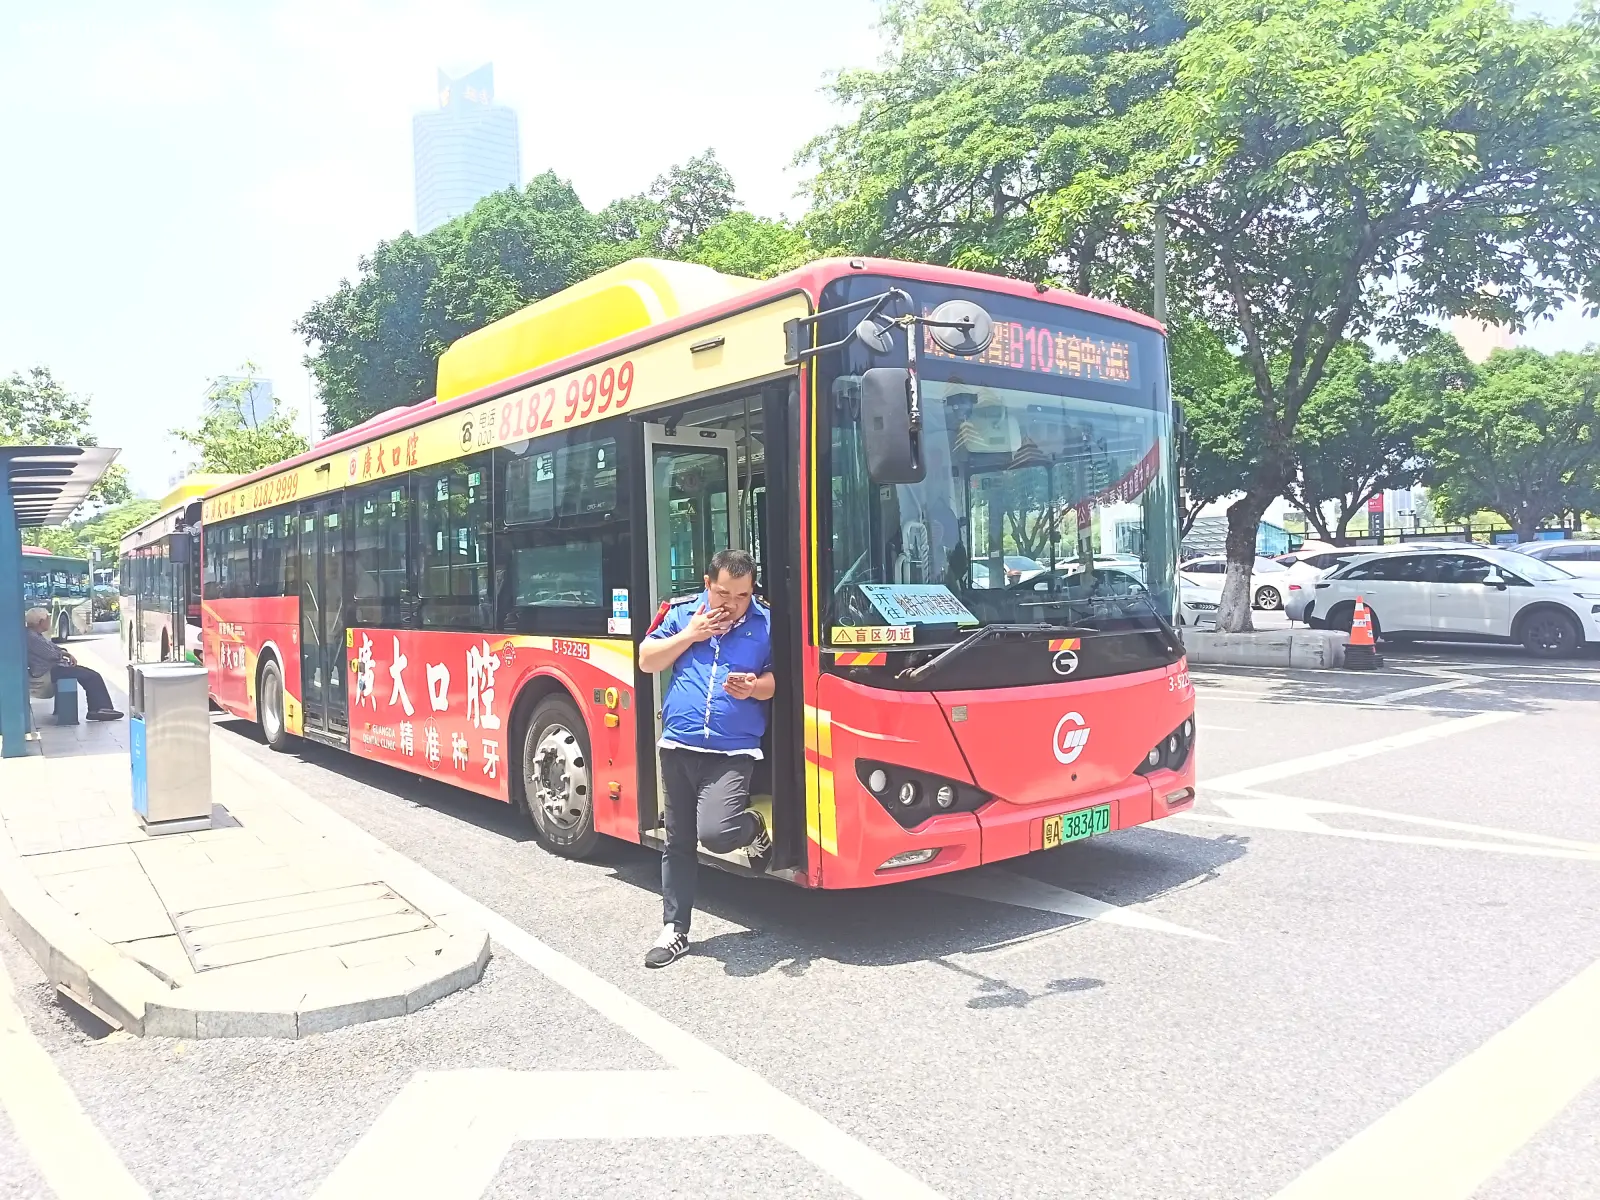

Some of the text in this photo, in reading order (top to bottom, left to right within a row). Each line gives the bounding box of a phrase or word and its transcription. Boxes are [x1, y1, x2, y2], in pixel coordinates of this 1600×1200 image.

[1010, 322, 1054, 373] B10
[499, 360, 634, 441] 8182 9999
[479, 408, 496, 429] 电话
[253, 481, 274, 508] 8182
[275, 473, 299, 502] 9999
[554, 640, 588, 658] 3-52296
[855, 627, 912, 643] 盲区勿近
[355, 632, 501, 730] 廣大口腔
